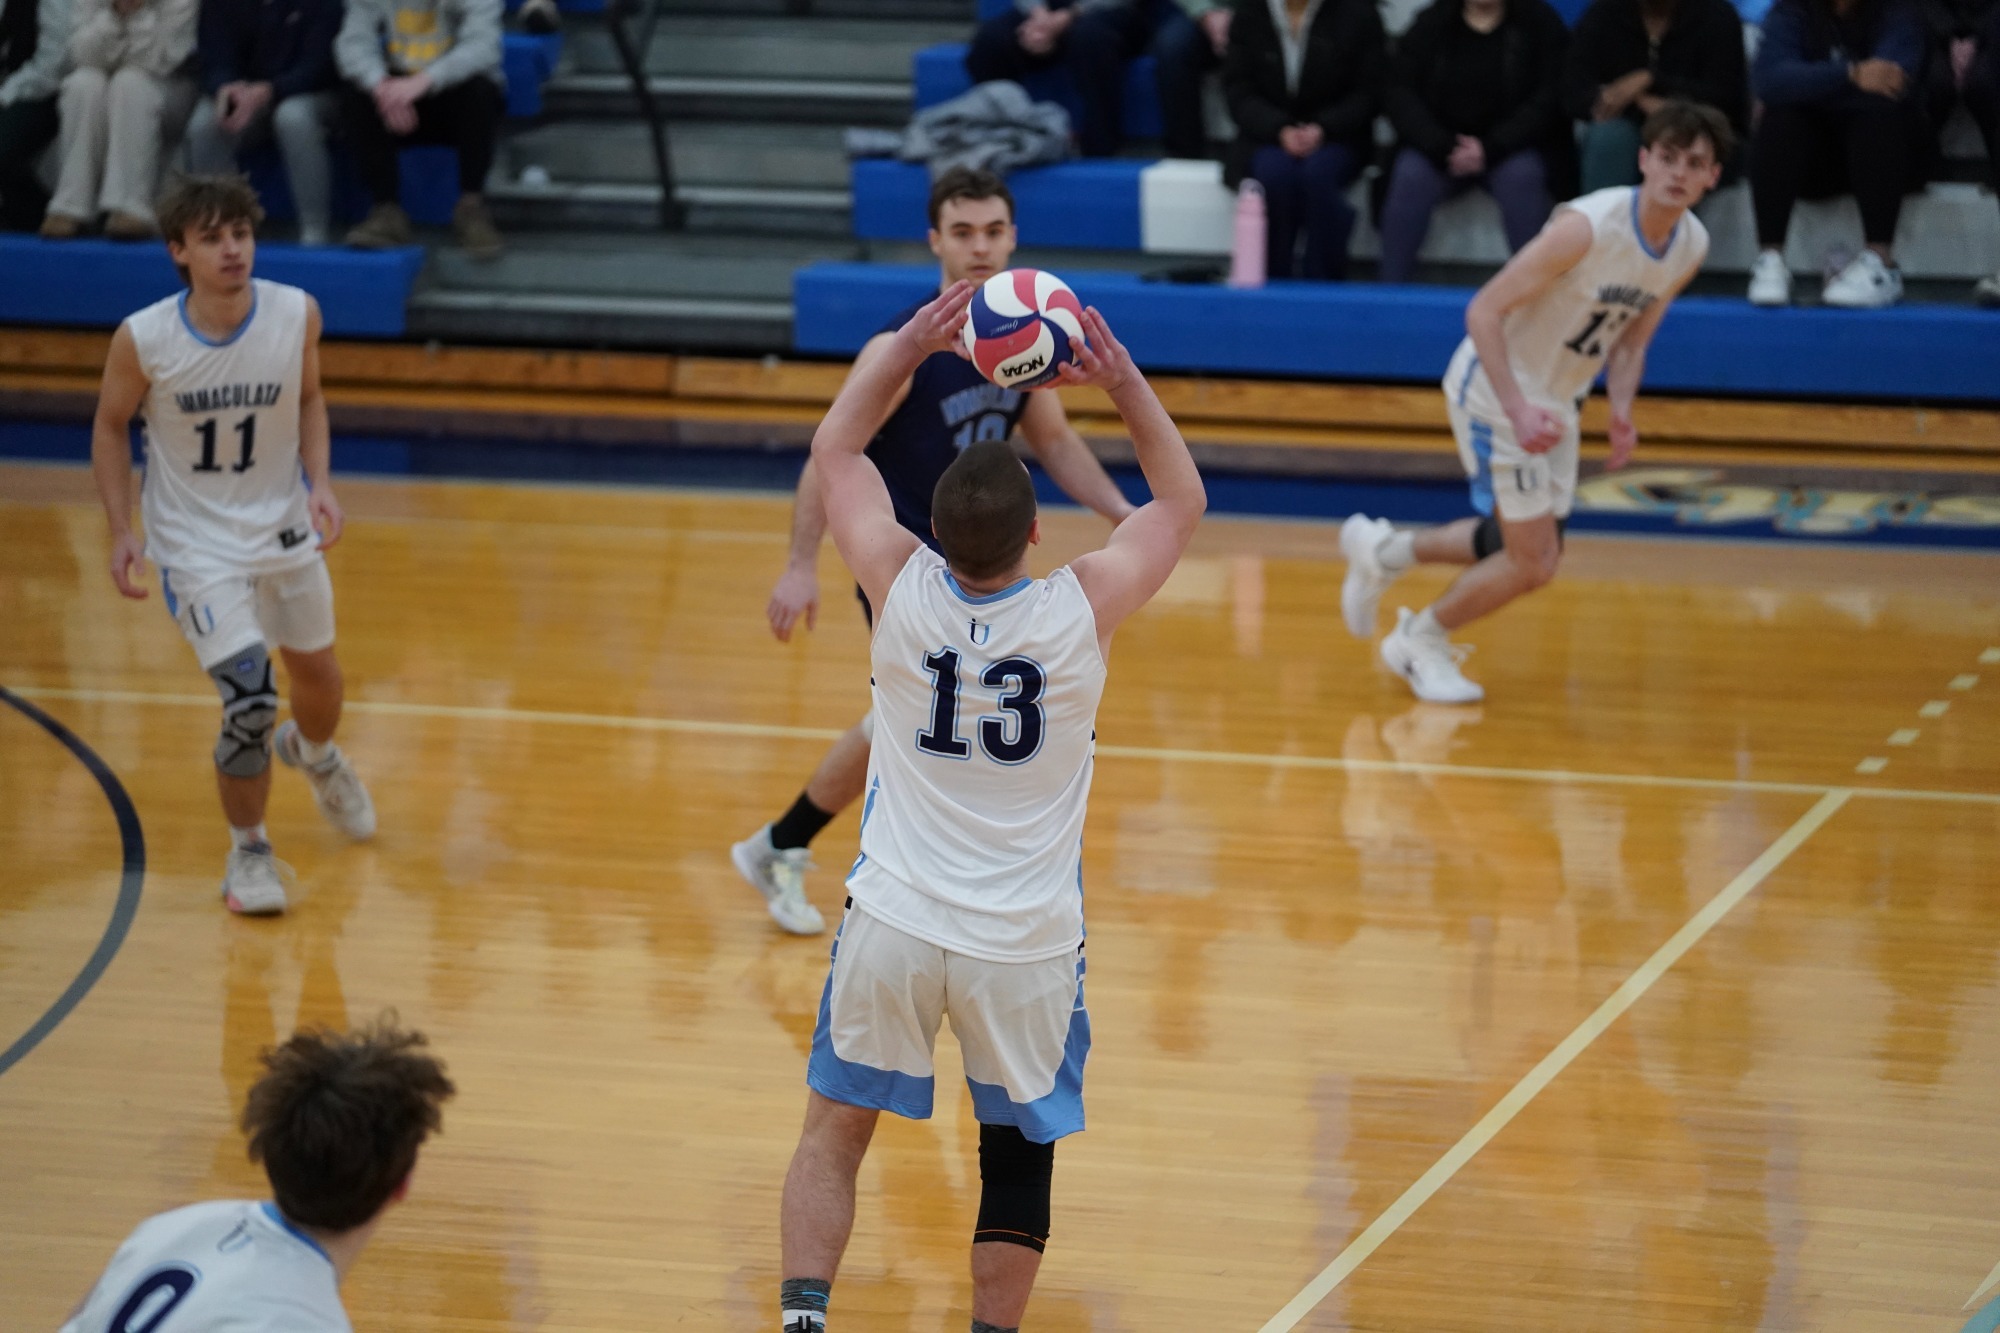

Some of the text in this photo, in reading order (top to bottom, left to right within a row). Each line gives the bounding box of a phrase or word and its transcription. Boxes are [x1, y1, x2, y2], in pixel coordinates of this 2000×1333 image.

[1001, 355, 1045, 378] NCAA
[191, 413, 257, 473] 11
[915, 645, 1048, 767] 13
